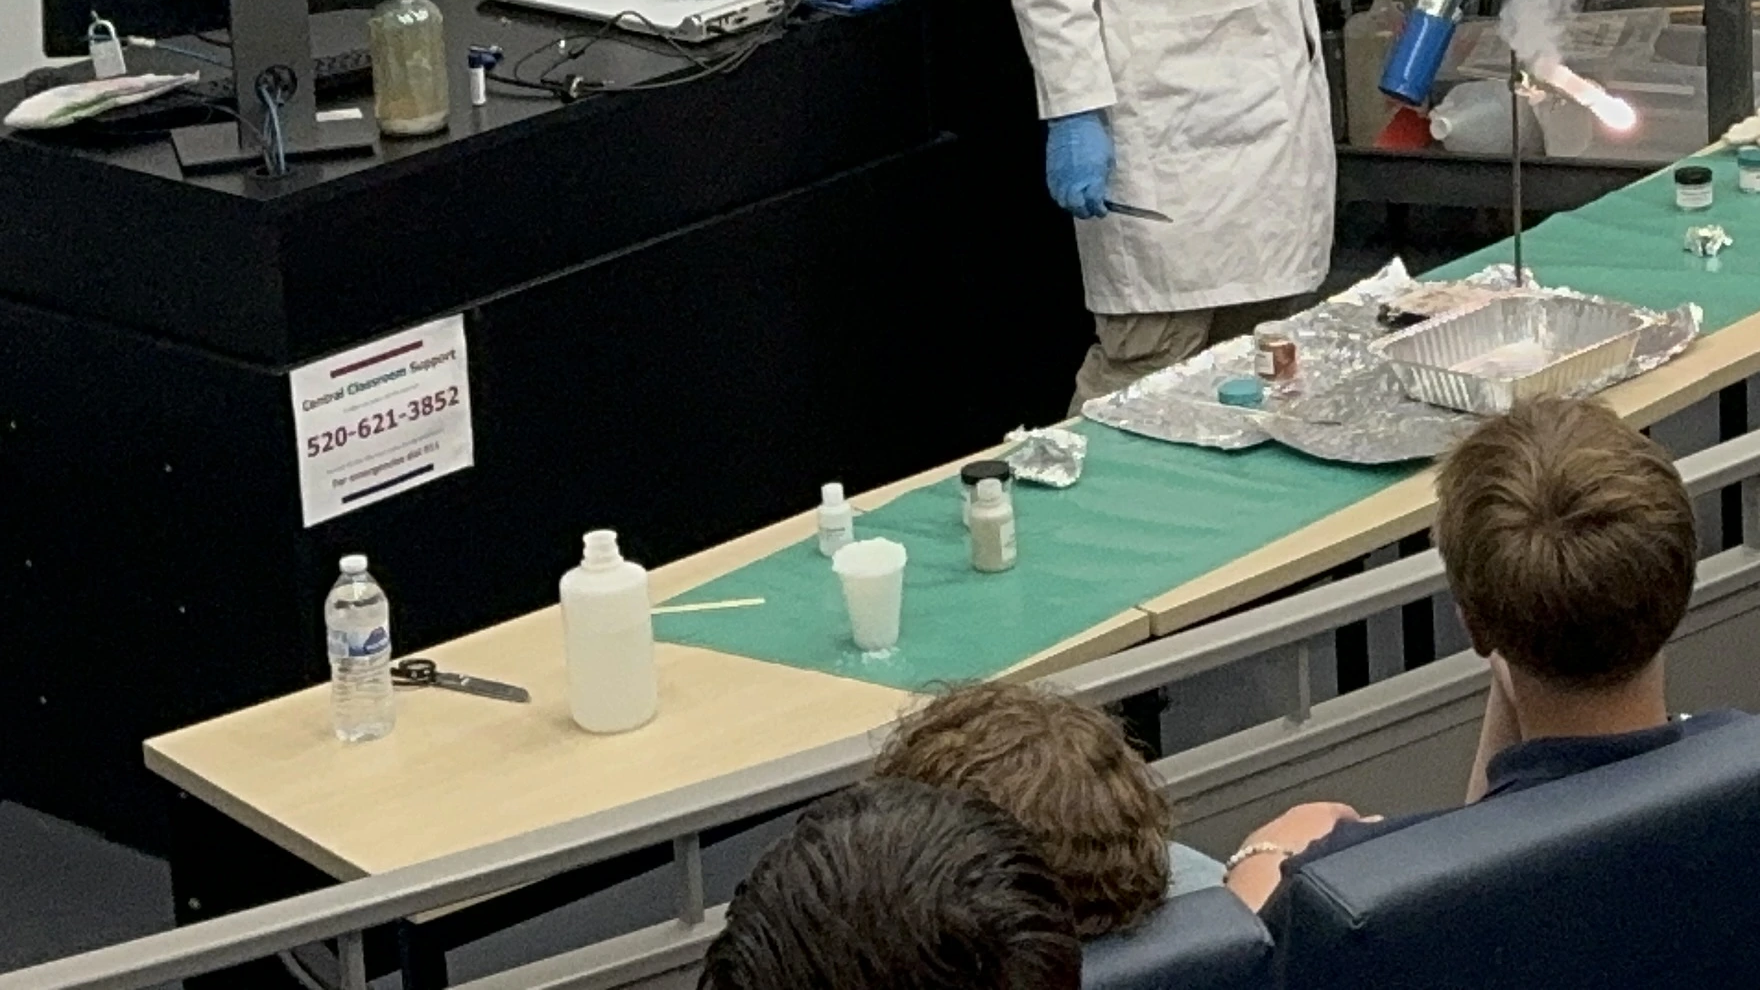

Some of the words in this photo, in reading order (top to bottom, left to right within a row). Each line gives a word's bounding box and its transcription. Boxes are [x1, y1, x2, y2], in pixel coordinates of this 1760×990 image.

[302, 386, 345, 412] Central
[346, 366, 407, 396] Classroom
[409, 348, 457, 374] Support
[306, 385, 460, 458] 520-621-3852
